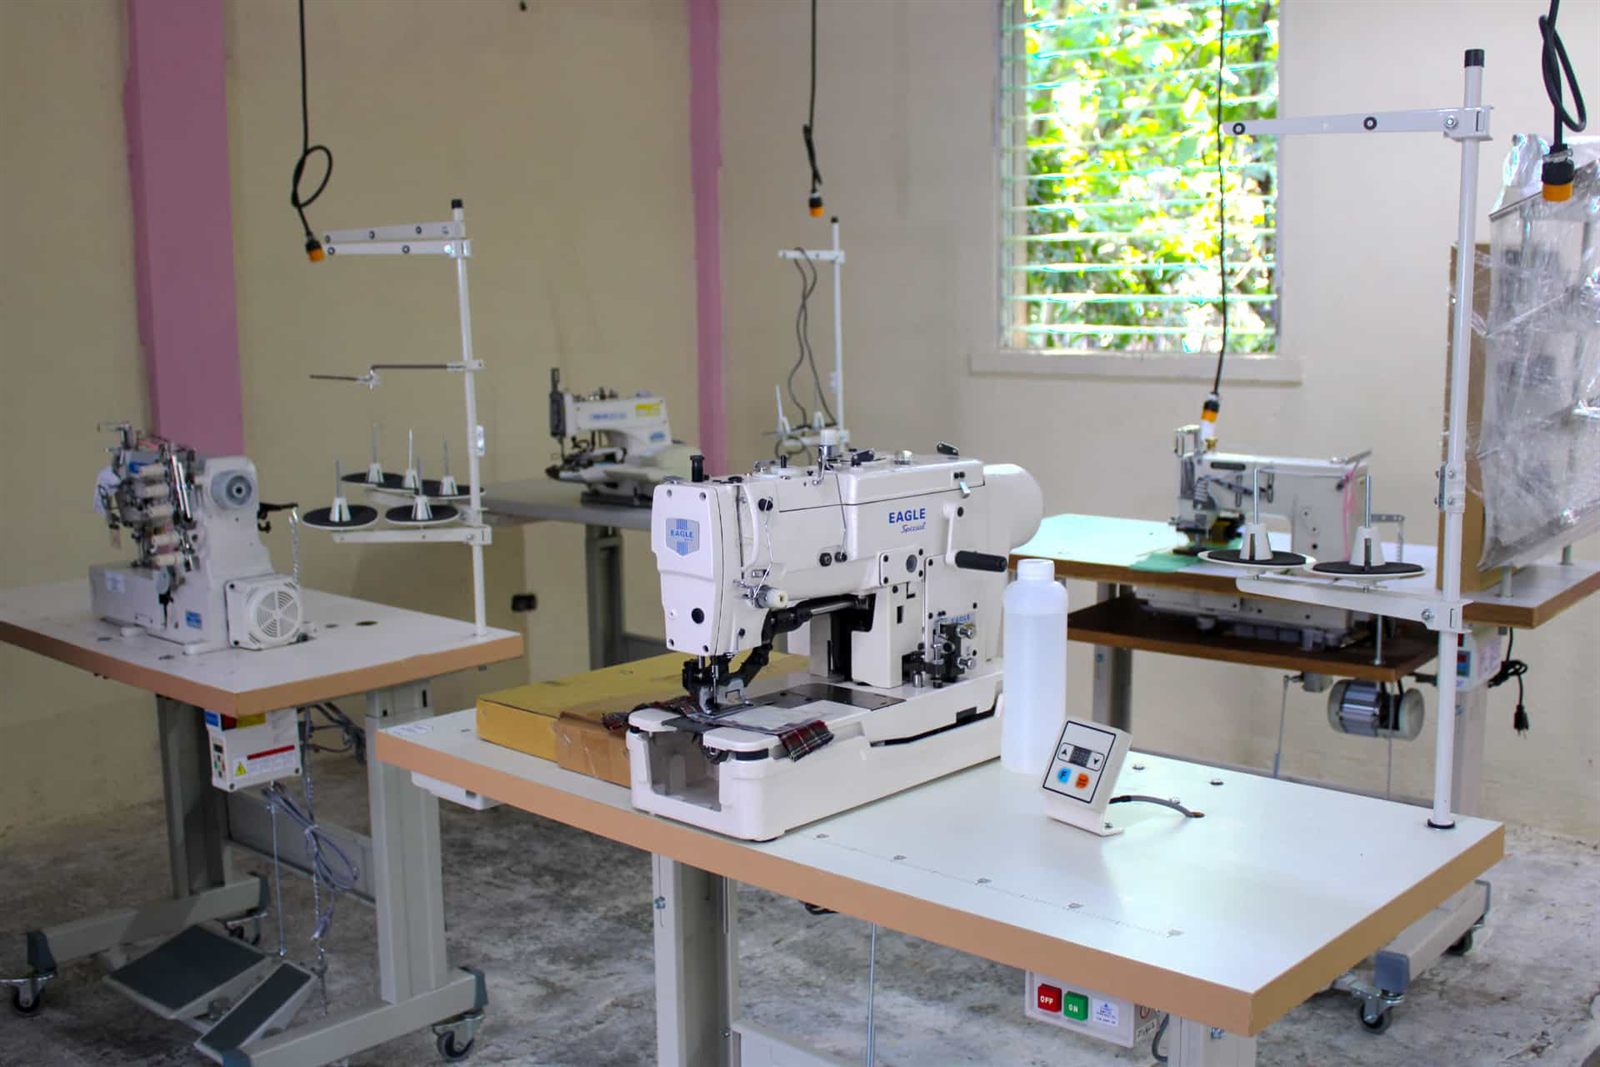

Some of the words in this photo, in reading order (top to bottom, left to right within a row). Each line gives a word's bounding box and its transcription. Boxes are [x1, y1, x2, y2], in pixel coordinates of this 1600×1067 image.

[888, 508, 926, 523] EAGLE
[670, 529, 694, 538] EAGLE
[1040, 995, 1054, 1005] OFF
[1068, 1003, 1079, 1013] ON
